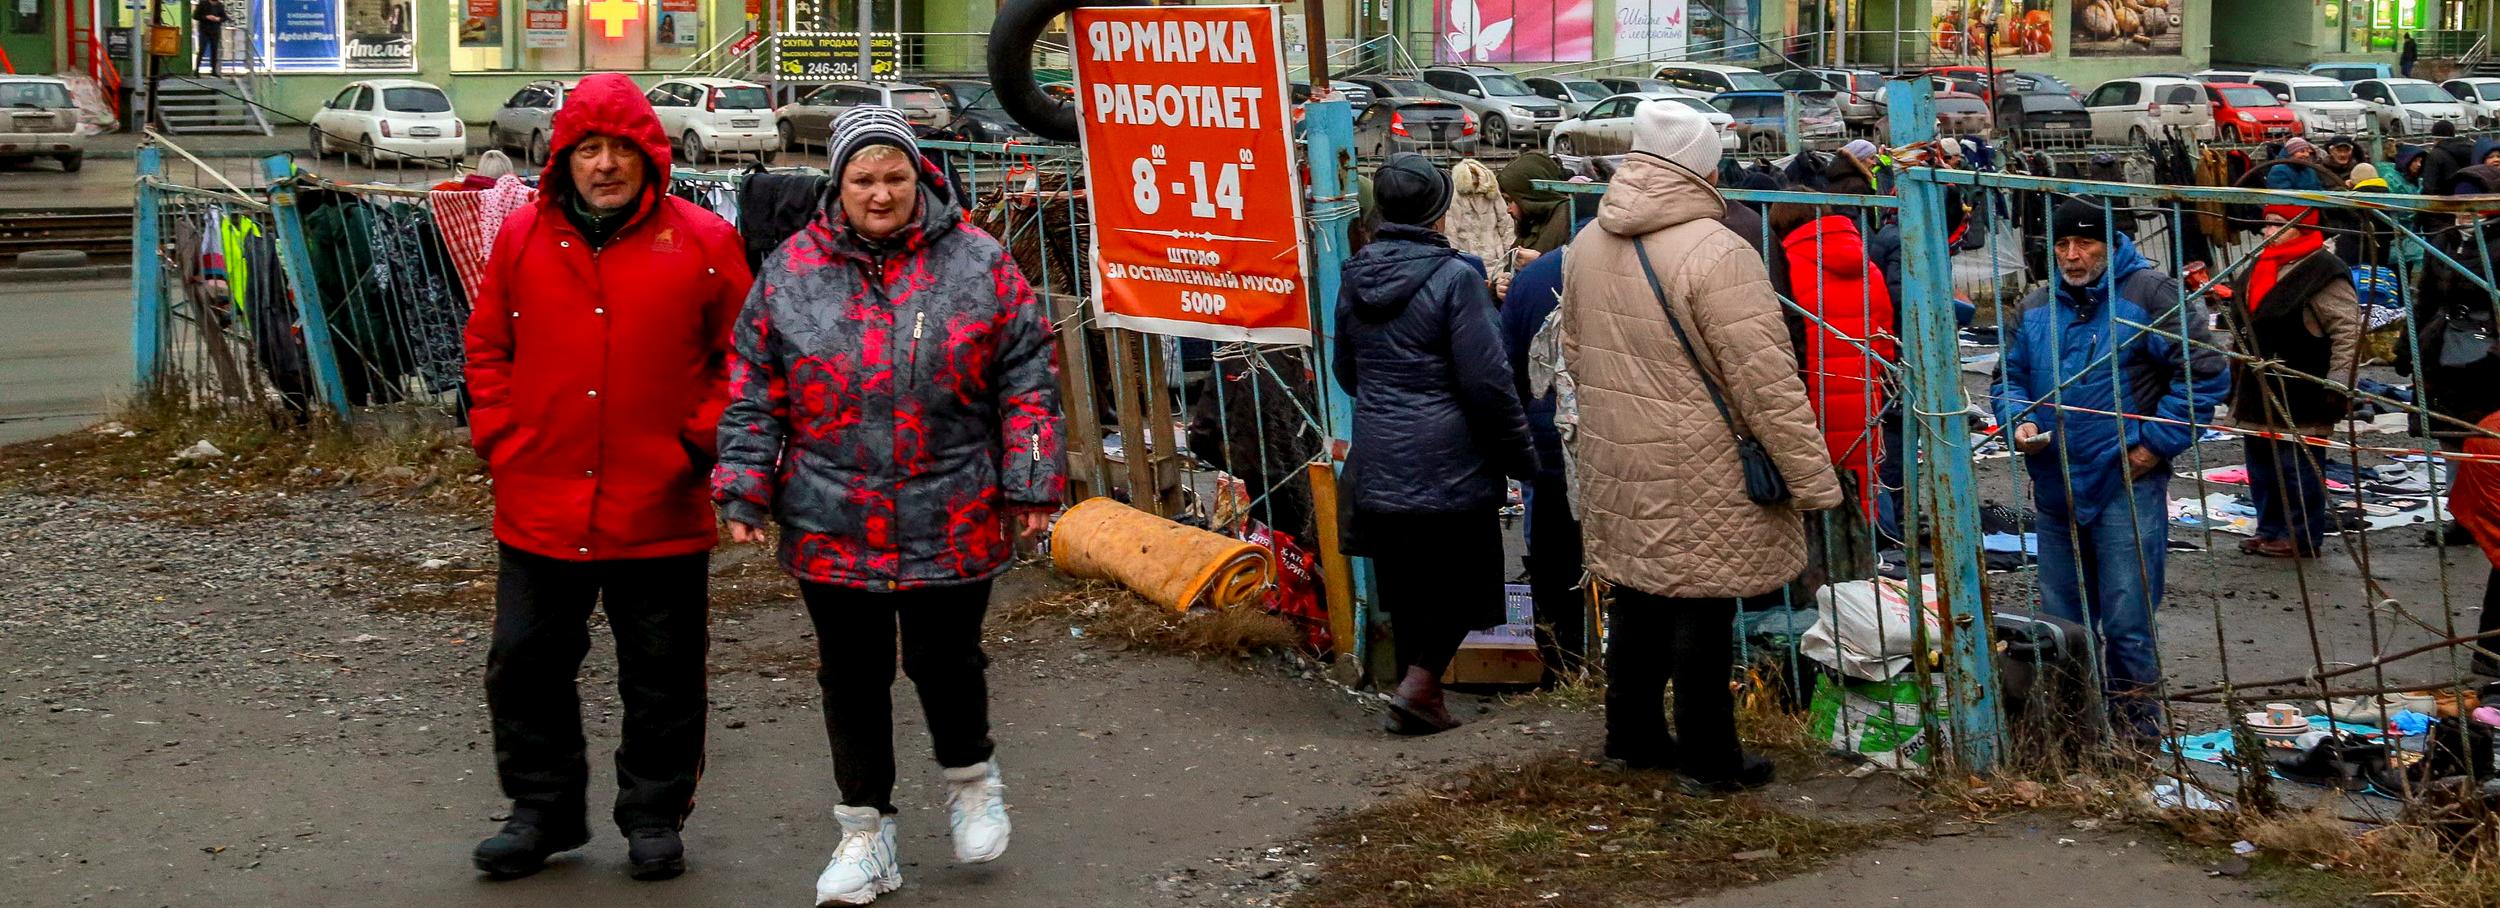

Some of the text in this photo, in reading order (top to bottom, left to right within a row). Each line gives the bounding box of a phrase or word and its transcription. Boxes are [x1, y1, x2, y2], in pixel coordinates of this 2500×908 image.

[346, 39, 411, 58] Ателье
[782, 39, 893, 48] СКУПКА ПРОДАЖА БМЕН
[1088, 21, 1256, 63] ЯРМАРКА
[1093, 83, 1262, 129] РАБОТАЕТ
[1166, 247, 1220, 266] ШТРАФ
[1106, 262, 1296, 295] ЗА ОСТАВЛЕННЫЙ МУСОР
[1249, 532, 1270, 547] ДЛЯ
